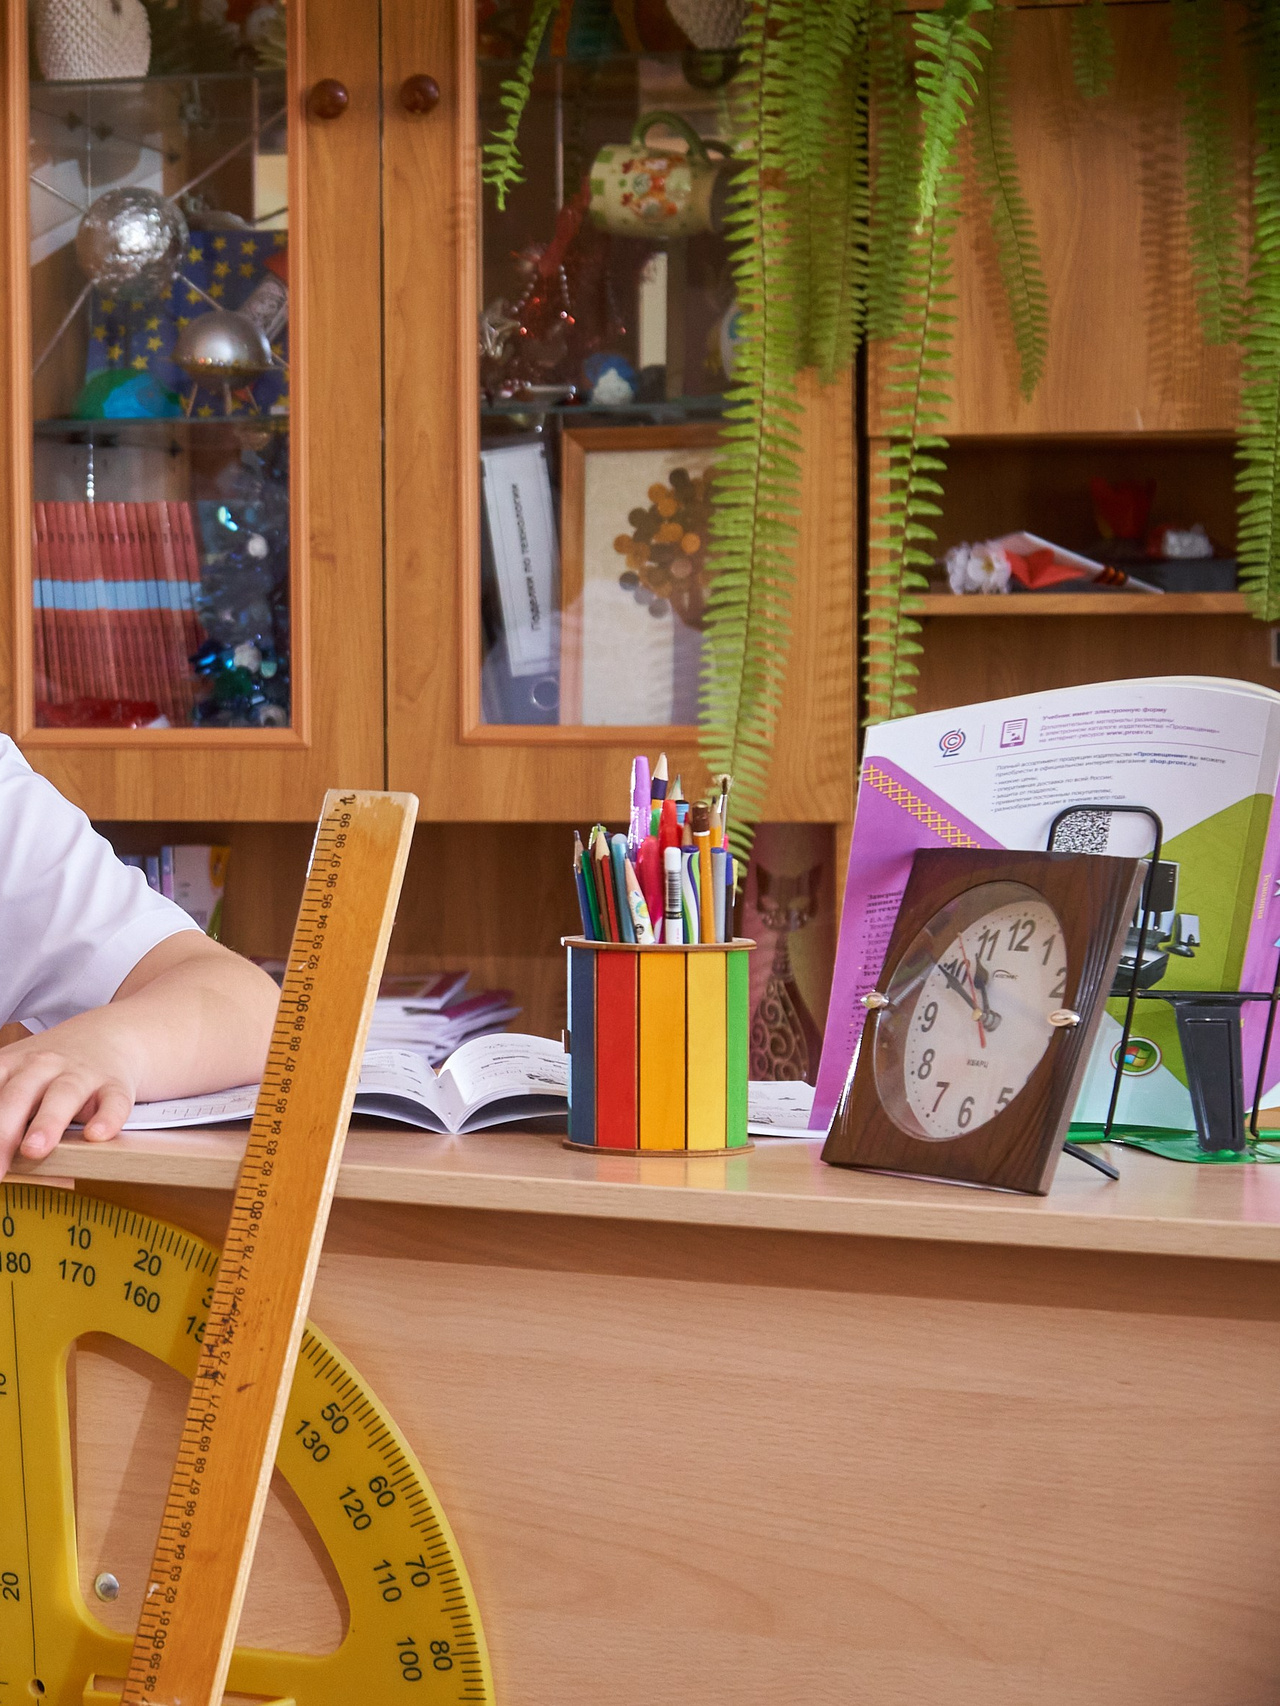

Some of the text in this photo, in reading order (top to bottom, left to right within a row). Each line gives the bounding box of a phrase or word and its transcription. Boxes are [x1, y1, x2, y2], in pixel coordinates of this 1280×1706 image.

[511, 484, 541, 631] Поделки по технологии
[1042, 713, 1070, 721] Учебник
[1094, 707, 1141, 715] электронную
[996, 762, 1020, 771] Полный
[1021, 758, 1058, 767] ассортимент
[1059, 755, 1092, 763] продукции
[1133, 751, 1188, 759] «Просвещение»
[339, 813, 352, 828] 99
[335, 833, 347, 849] 98
[330, 853, 343, 868] 97
[326, 873, 339, 889] 96
[321, 893, 334, 909] 95
[317, 914, 329, 929] 94
[312, 934, 325, 950] 93
[1007, 918, 1038, 953] 12
[977, 929, 1001, 962] 11
[1041, 934, 1056, 967] 1
[307, 954, 321, 970] 92
[303, 976, 315, 991] 91
[1049, 966, 1068, 1000] 2
[296, 994, 311, 1013] 90
[294, 1015, 306, 1031] 89
[920, 1001, 939, 1033] 9
[289, 1036, 302, 1052] 88
[285, 1057, 297, 1073] 87
[917, 1047, 936, 1080] 8
[280, 1078, 292, 1094] 86
[930, 1081, 951, 1113] 7
[993, 1086, 1014, 1117] 5
[275, 1098, 288, 1114] 85
[957, 1095, 976, 1128] 6
[271, 1119, 283, 1135] 84
[266, 1140, 279, 1156] 83
[261, 1160, 274, 1177] 82
[257, 1183, 269, 1198] 81
[250, 1200, 265, 1220] 80
[247, 1223, 260, 1239] 79
[242, 1244, 255, 1261] 78
[237, 1265, 251, 1282] 77
[233, 1286, 246, 1303] 76
[228, 1308, 241, 1324] 75
[219, 1350, 232, 1366] 73
[214, 1371, 227, 1387] 72
[209, 1393, 222, 1409] 71
[201, 1413, 217, 1433] 70
[2, 1216, 15, 1238] 0
[67, 1225, 92, 1250] 10
[133, 1248, 162, 1277] 20
[321, 1401, 349, 1435] 50
[368, 1475, 396, 1508] 60
[405, 1554, 431, 1588] 70
[429, 1640, 453, 1672] 80
[199, 1435, 212, 1452] 69
[58, 1259, 96, 1287] 170
[123, 1280, 161, 1313] 160
[294, 1418, 331, 1463] 130
[338, 1485, 373, 1532] 120
[373, 1559, 402, 1603] 110
[396, 1636, 423, 1683] 100
[194, 1457, 207, 1474] 68
[189, 1478, 202, 1495] 67
[184, 1500, 197, 1517] 66
[179, 1521, 192, 1538] 65
[175, 1543, 187, 1560] 64
[169, 1565, 182, 1582] 63
[1, 1571, 21, 1602] 20
[165, 1586, 178, 1604] 62
[160, 1609, 172, 1626] 61
[152, 1629, 168, 1650] 60
[149, 1653, 162, 1670] 59
[144, 1675, 157, 1692] 58
